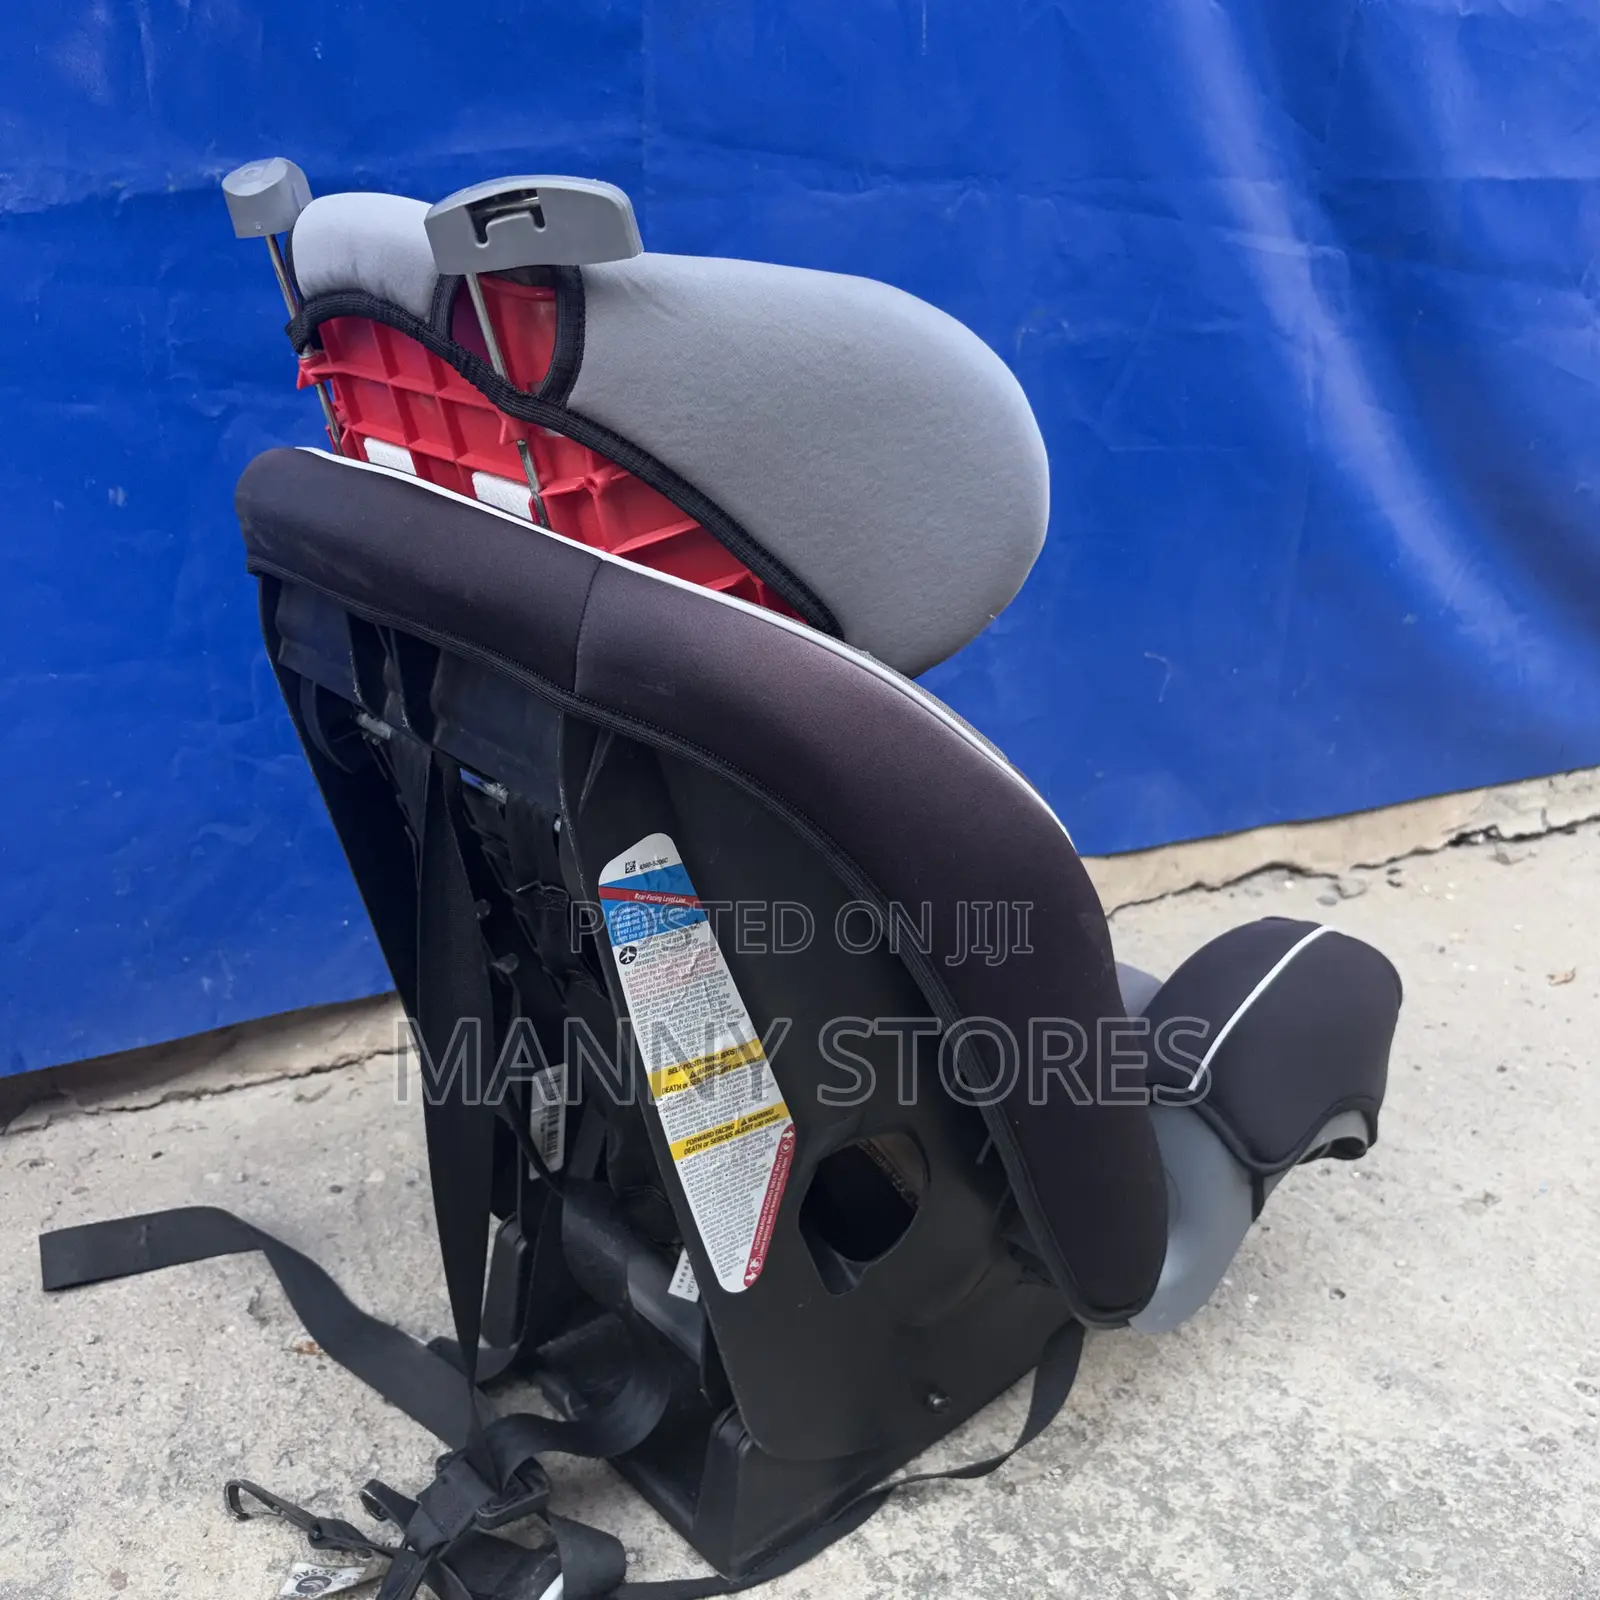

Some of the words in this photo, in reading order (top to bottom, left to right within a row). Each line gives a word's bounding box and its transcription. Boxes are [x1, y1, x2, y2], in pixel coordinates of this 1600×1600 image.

[634, 892, 662, 903] Rear-Facing
[663, 895, 676, 903] Level
[662, 1082, 681, 1094] DEATH
[684, 1143, 701, 1154] DEATH
[710, 1130, 733, 1144] SERIOUS
[734, 1123, 752, 1135] INJURY
[686, 1131, 713, 1146] FORWARD
[715, 1123, 734, 1135] FACING
